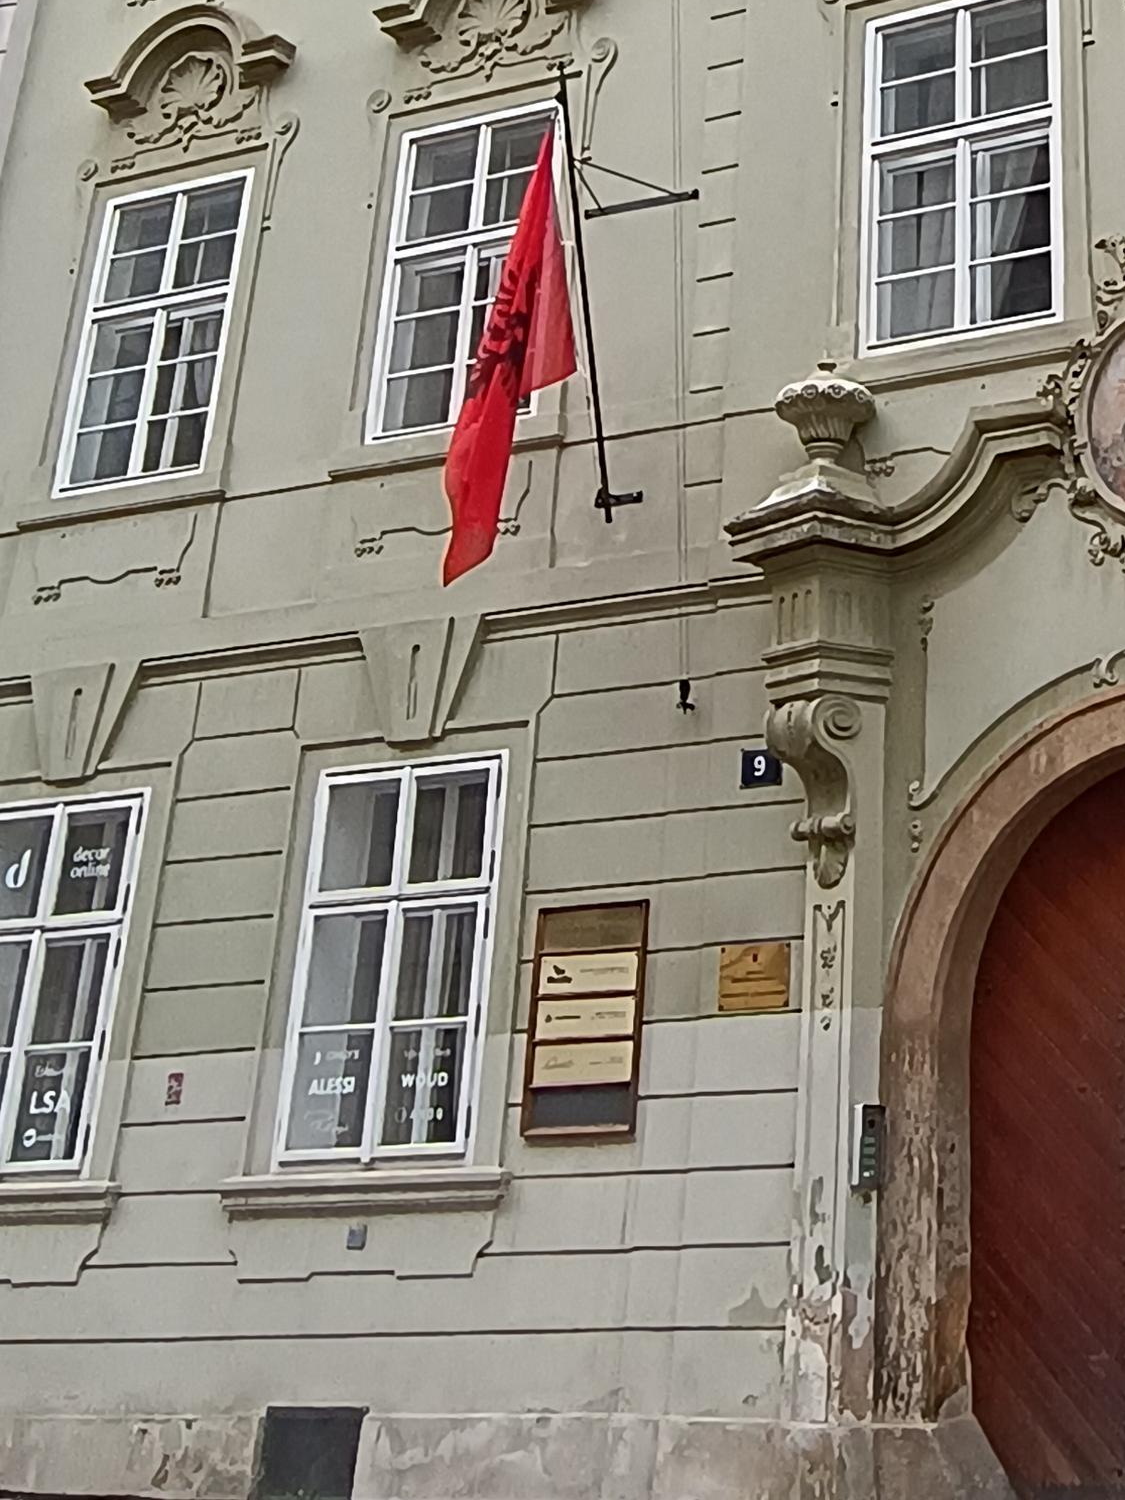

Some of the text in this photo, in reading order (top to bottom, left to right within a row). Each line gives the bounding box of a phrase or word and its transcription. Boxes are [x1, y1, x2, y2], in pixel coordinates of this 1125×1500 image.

[753, 755, 766, 777] 9
[5, 849, 31, 888] d
[308, 1076, 355, 1095] ALESSI
[401, 1072, 448, 1088] WOUD
[29, 1089, 70, 1115] LSA
